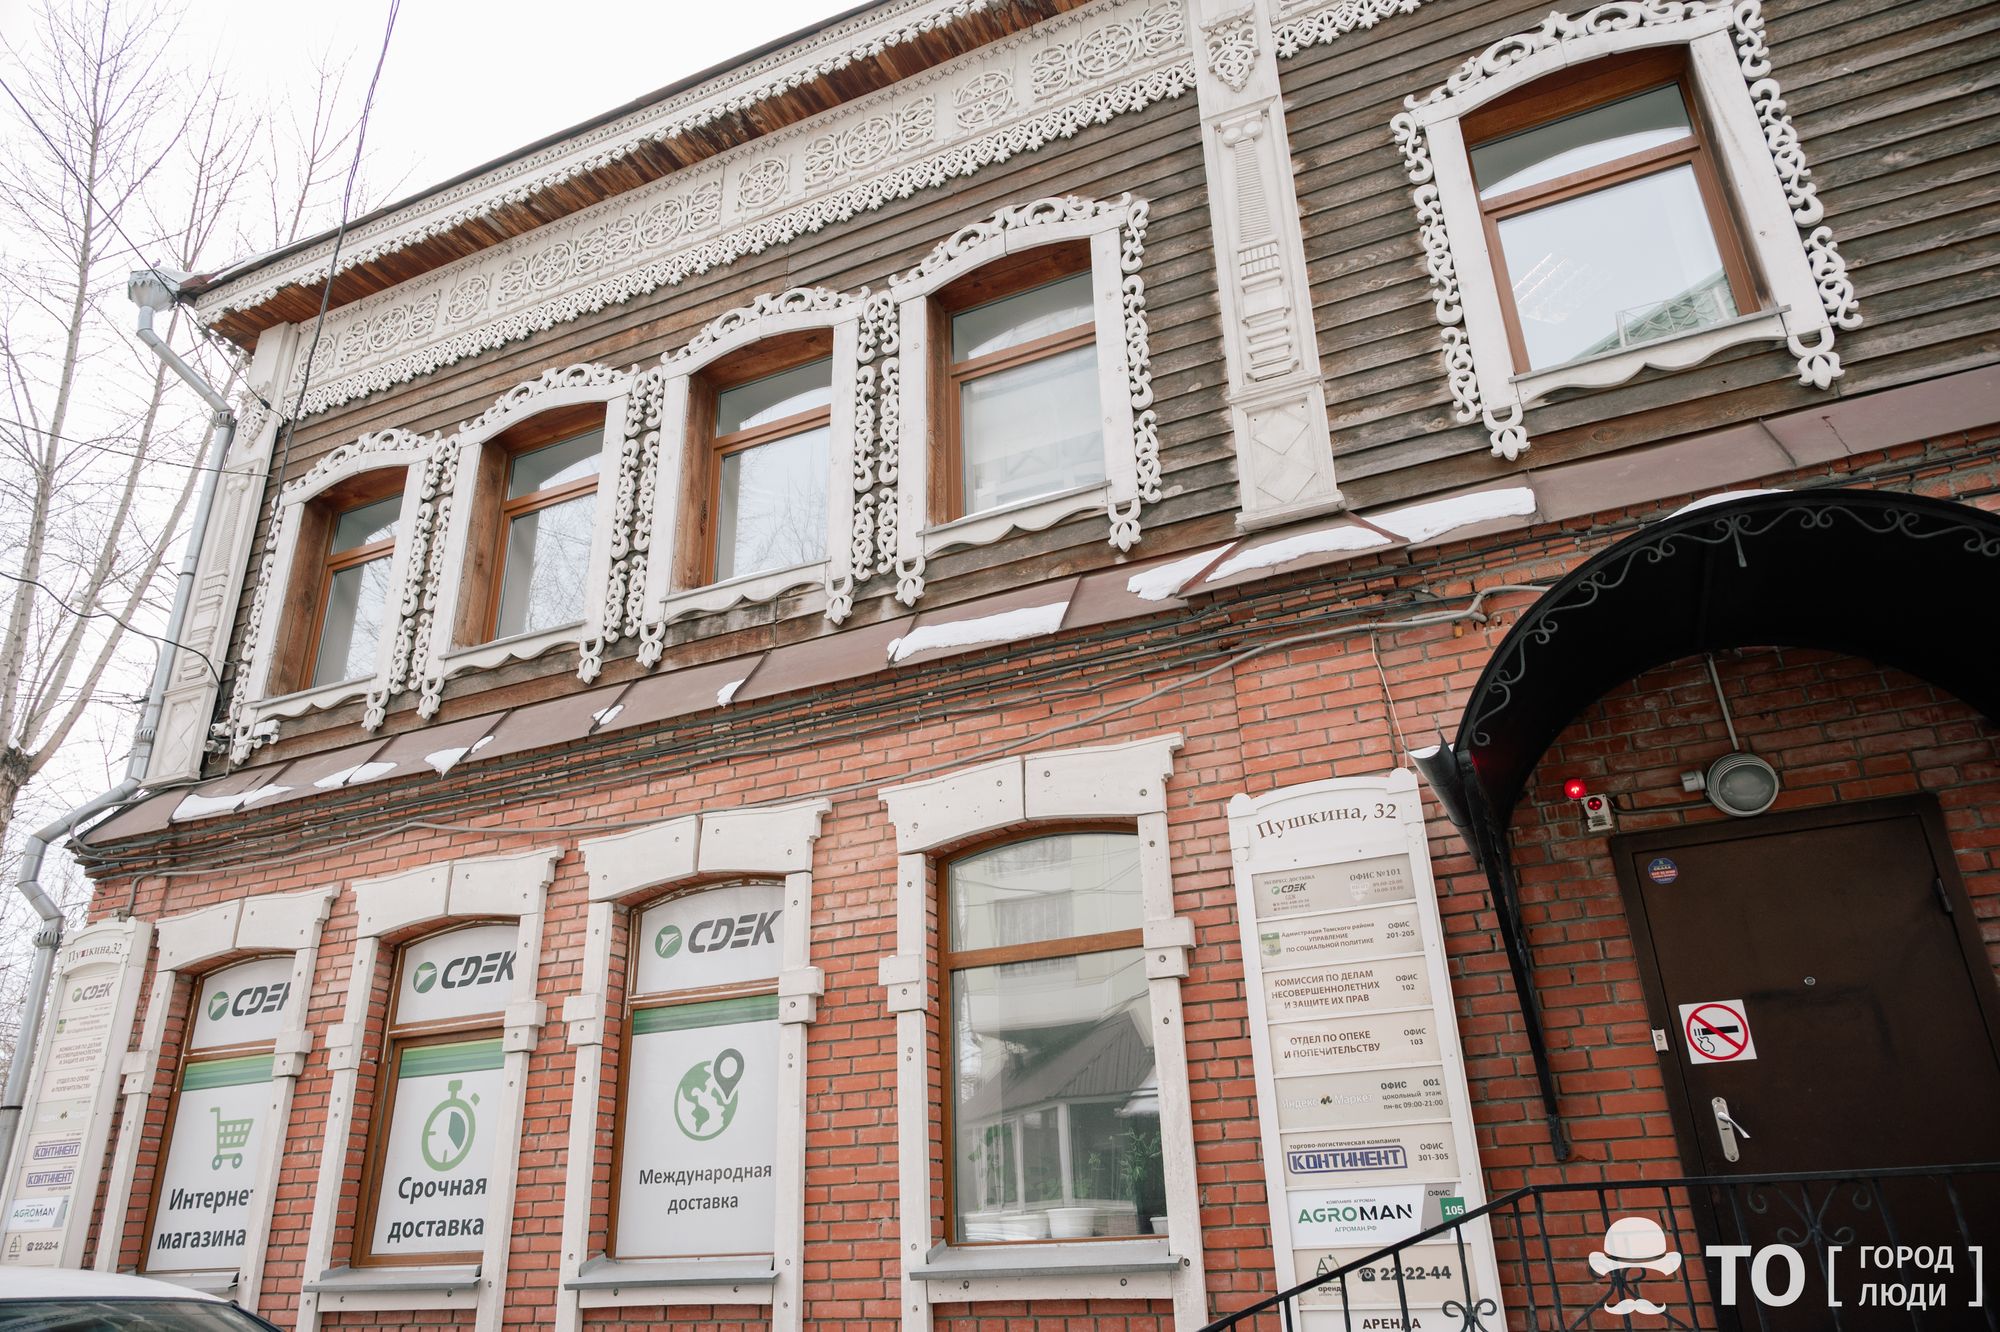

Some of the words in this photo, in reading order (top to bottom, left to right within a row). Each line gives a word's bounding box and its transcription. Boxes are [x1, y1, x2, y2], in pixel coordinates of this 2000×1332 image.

[1256, 807, 1367, 839] Пушкина,
[1374, 803, 1397, 819] 32
[1350, 872, 1375, 881] ОФИС
[1281, 883, 1307, 893] CDEK
[688, 909, 783, 954] CDEK
[1388, 921, 1410, 930] ОФИС
[1308, 933, 1349, 942] УПРАВЛЕНИЕ
[1386, 930, 1415, 939] 201-205
[1296, 941, 1339, 952] СОЦИАЛЬНОЙ
[1340, 938, 1374, 947] ПОЛИТИКЕ
[441, 950, 517, 989] CDEK
[1274, 975, 1324, 987] КОМИССИЯ
[1325, 973, 1339, 982] ПО
[1341, 969, 1374, 981] ДЕЛАМ
[1395, 973, 1418, 982] ОФИС
[82, 982, 114, 1000] CDEK
[1271, 981, 1380, 999] НЕСОВЕРШЕННОЛЕТНИХ
[1293, 997, 1329, 1009] ЗАЩИТЕ
[1331, 996, 1344, 1005] ИХ
[1346, 994, 1370, 1003] ПРАВ
[1290, 1036, 1321, 1046] ОТДЕЛ
[1323, 1034, 1337, 1043] ПО
[1338, 1030, 1371, 1041] ОПЕКЕ
[1403, 1027, 1426, 1036] ОФИС
[1284, 1051, 1291, 1059] И
[1293, 1042, 1381, 1058] ПОПЕЧИТЕЛЬСТВУ
[1380, 1081, 1407, 1090] ОФИС
[1422, 1078, 1440, 1087] 001
[1334, 1095, 1372, 1105] Маркет
[1382, 1091, 1422, 1101] цокольный
[1403, 1099, 1444, 1109] 09:00-21:00
[35, 1145, 79, 1157] КОНТИНЕНТ
[1289, 1140, 1365, 1150] торгово-логистическая
[1420, 1143, 1443, 1151] ОФИС
[1292, 1149, 1401, 1170] КОНТИНЕНТ
[1418, 1153, 1449, 1162] 301-305
[28, 1172, 73, 1184] КОНТИНЕНТ
[639, 1164, 772, 1186] Международная
[398, 1176, 487, 1204] Срочная
[169, 1188, 254, 1214] Интерне
[667, 1195, 738, 1215] доставка
[13, 1207, 55, 1218] AGROMAN
[1298, 1204, 1412, 1224] AGROMAN
[1445, 1205, 1464, 1215] 105
[387, 1217, 484, 1243] доставка
[1334, 1225, 1377, 1233] АГРОМАН.РФ
[157, 1229, 247, 1250] магазина
[1380, 1266, 1451, 1280] 22-22-44
